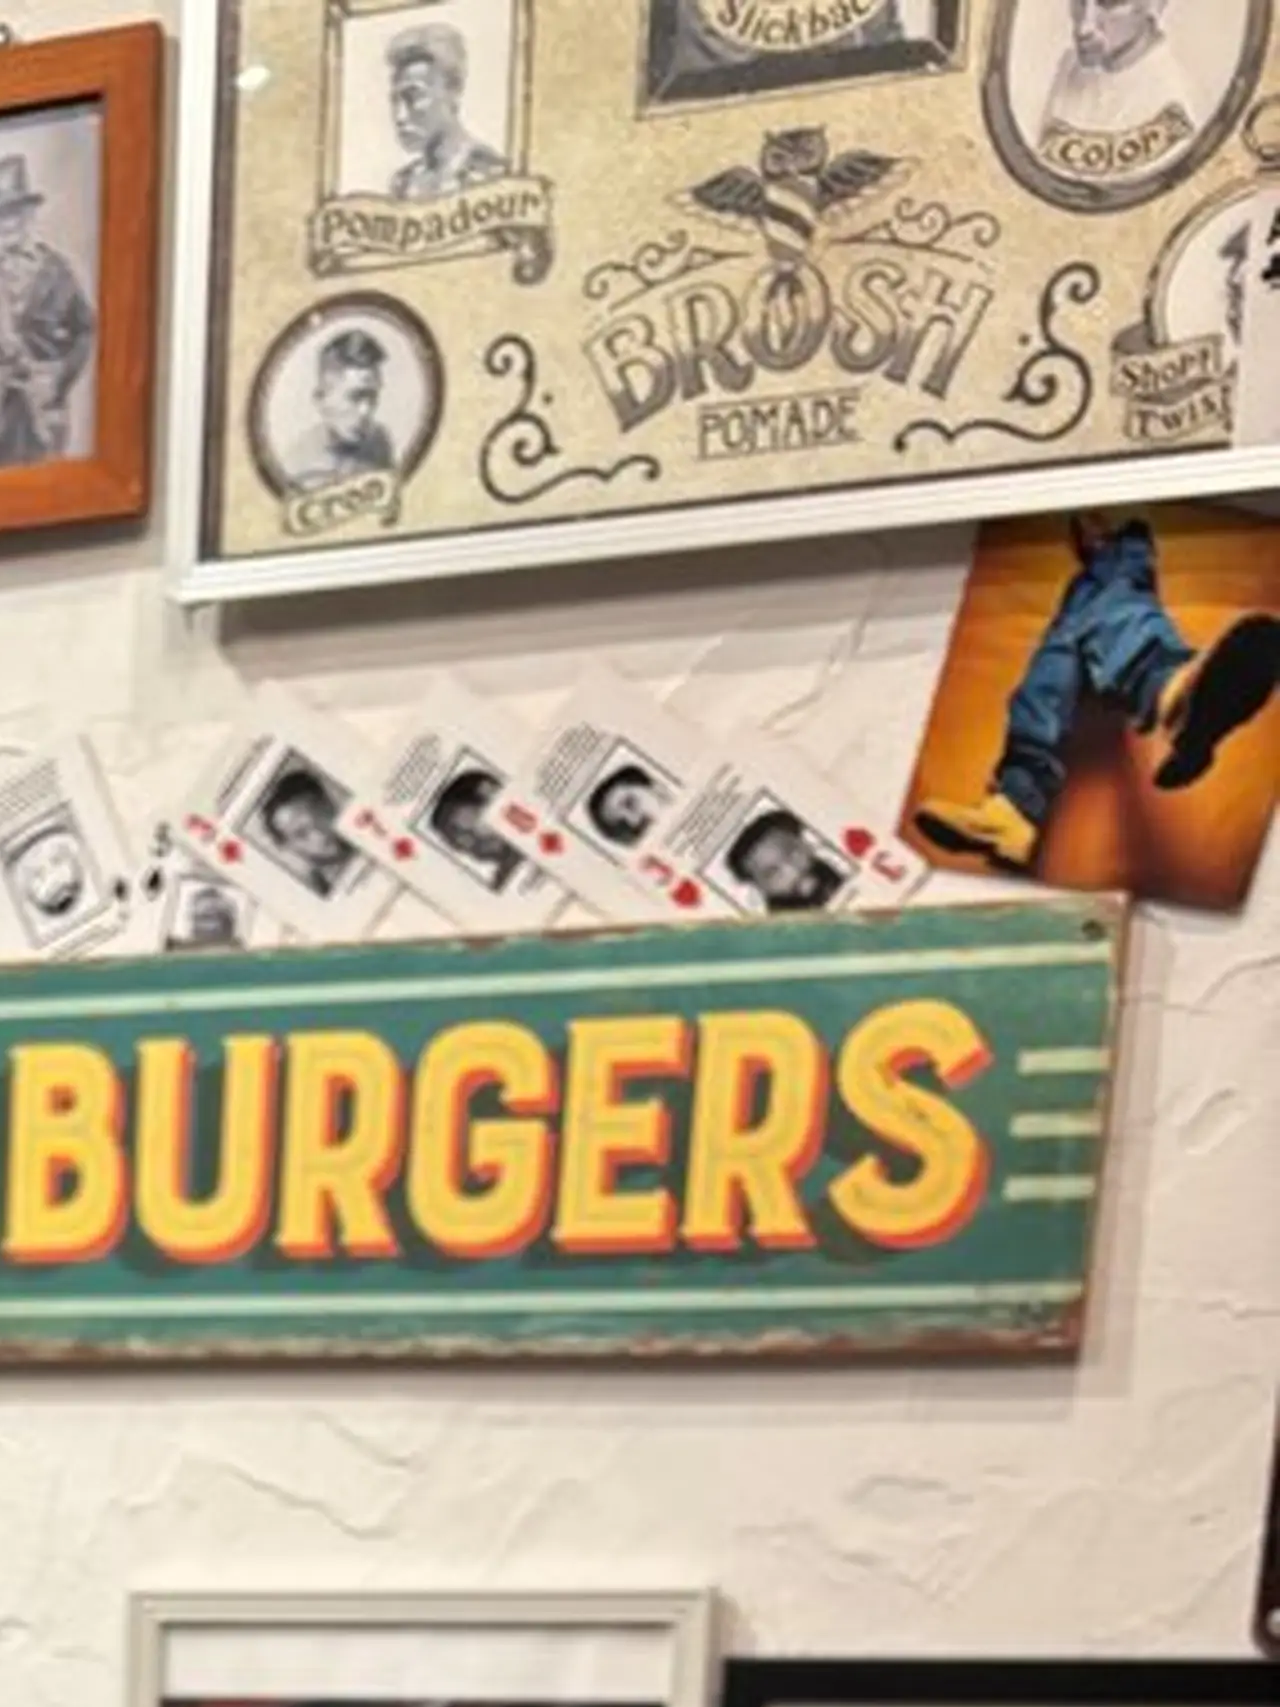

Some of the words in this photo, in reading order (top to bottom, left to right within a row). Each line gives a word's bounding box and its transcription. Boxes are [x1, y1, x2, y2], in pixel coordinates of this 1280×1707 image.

[320, 188, 541, 250] Pompadour
[582, 256, 995, 434] BROSH
[696, 398, 860, 460] POMADE
[2, 998, 998, 1264] BURGERS
